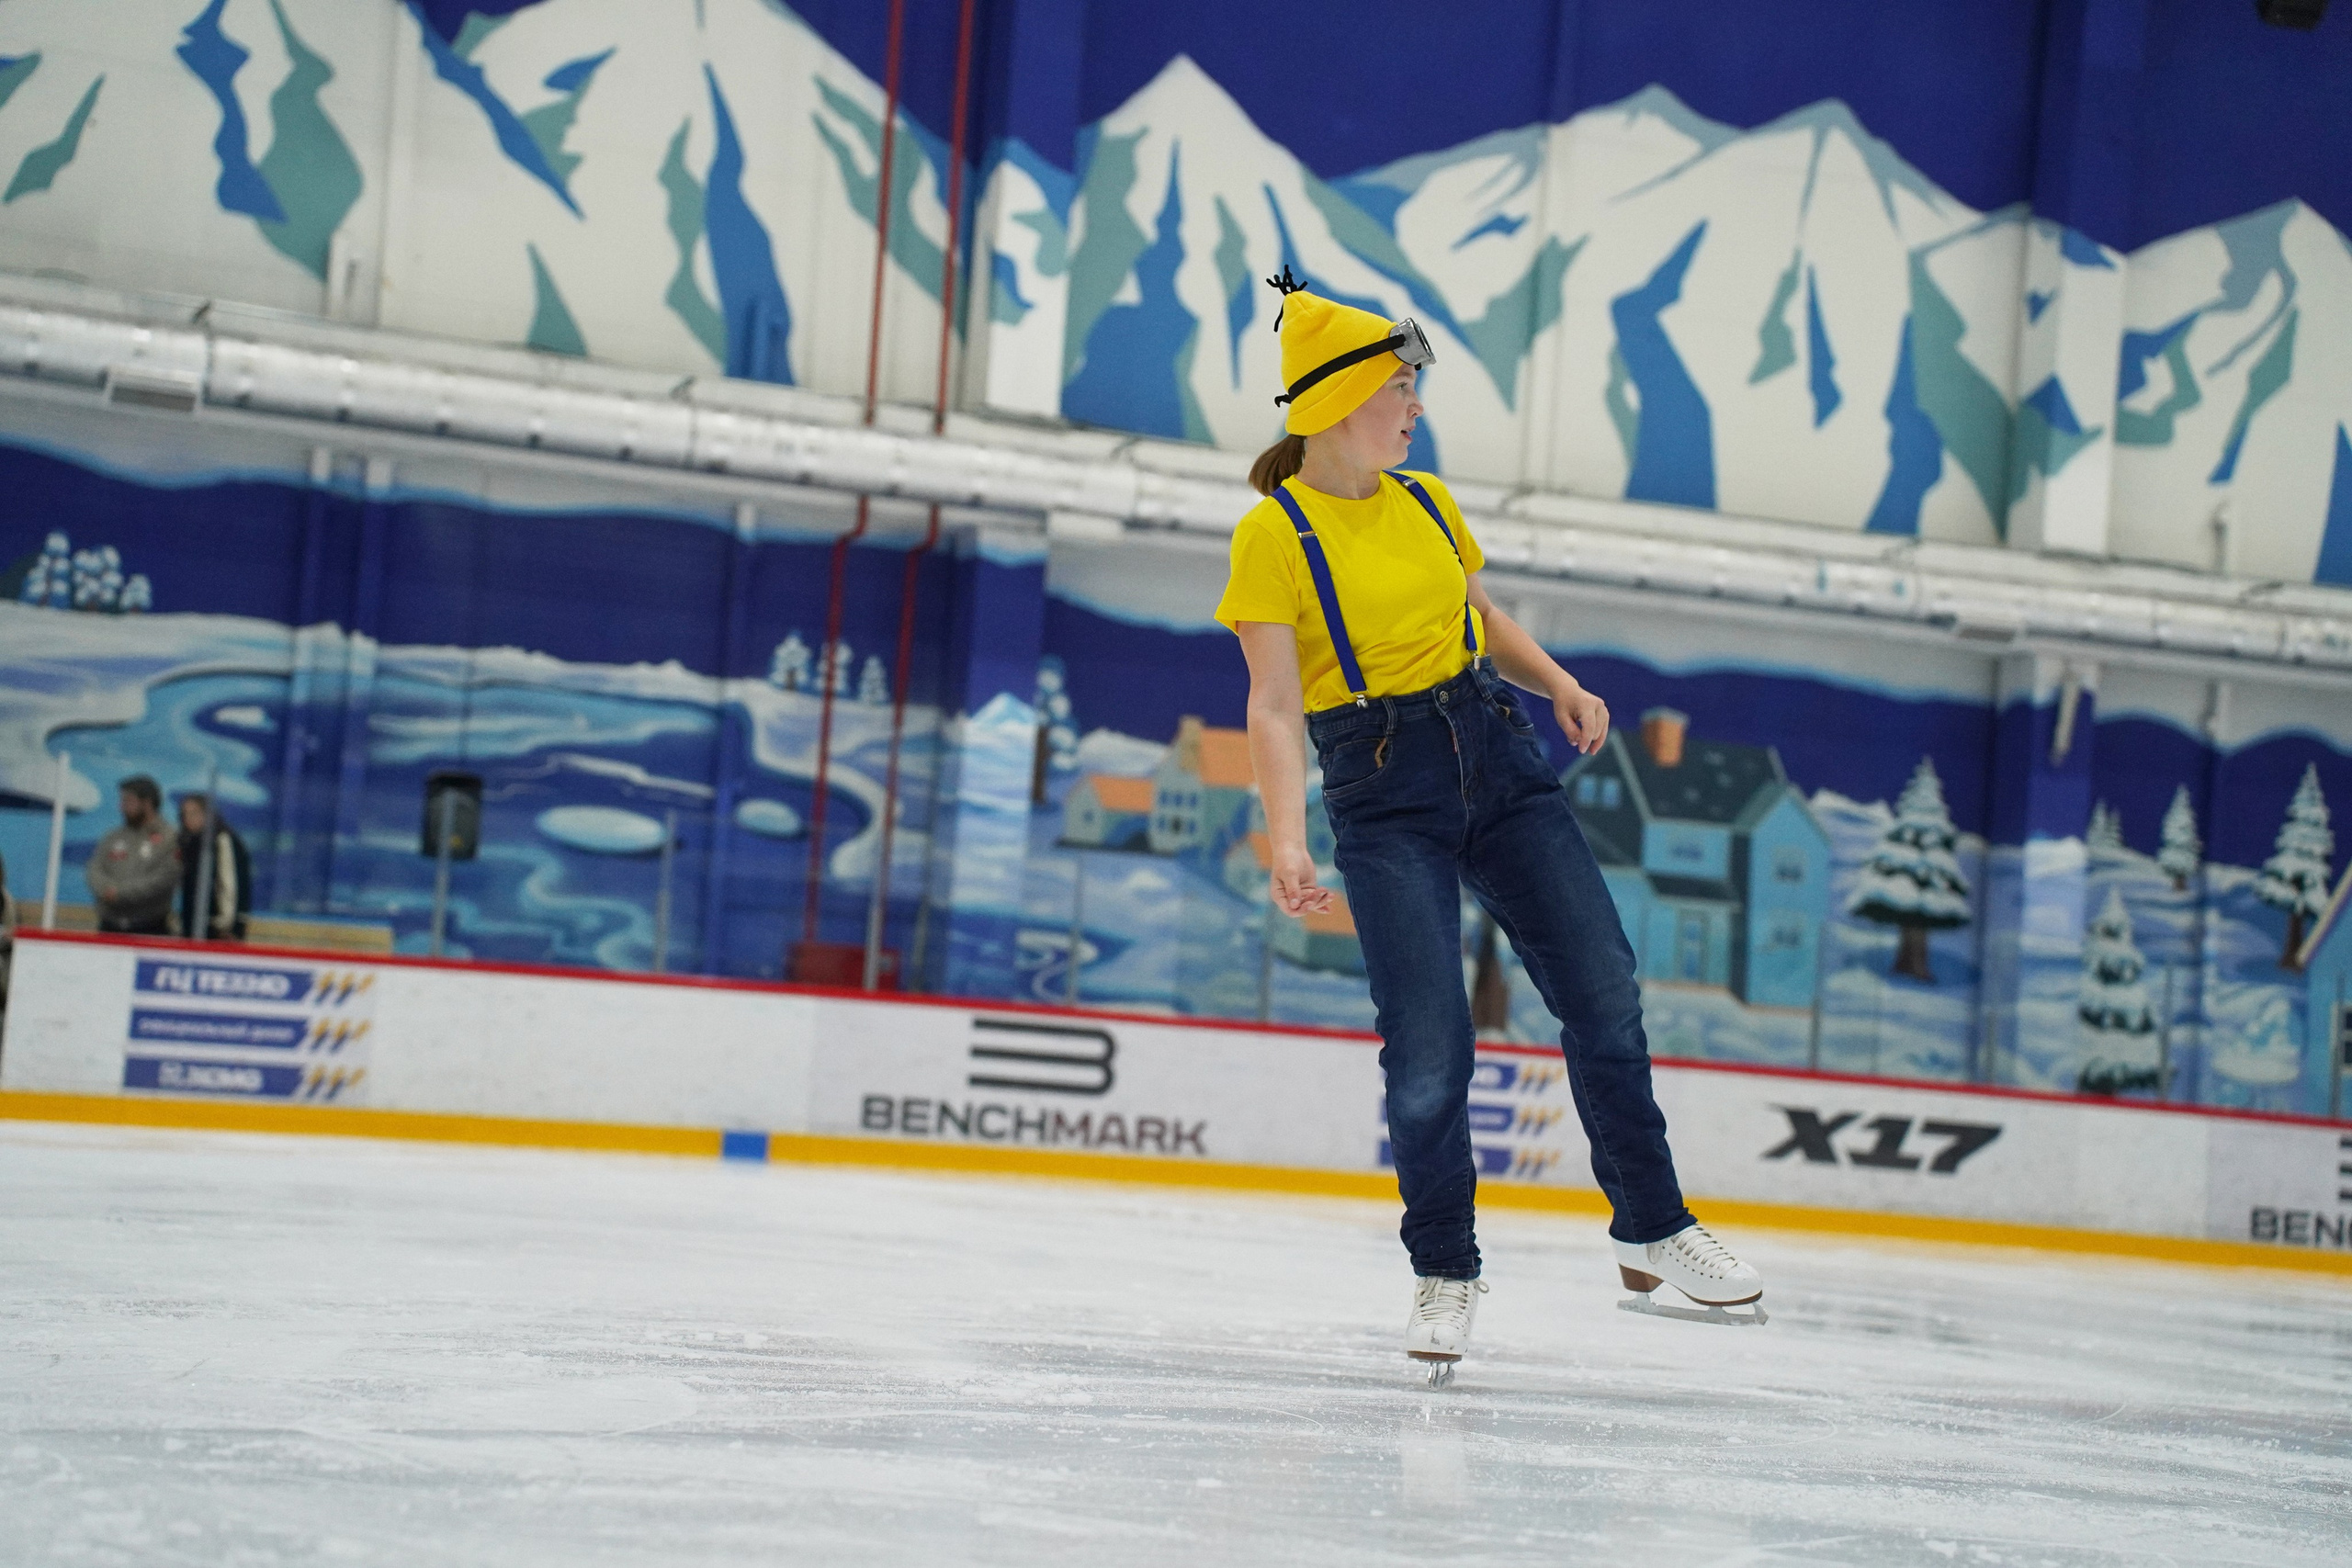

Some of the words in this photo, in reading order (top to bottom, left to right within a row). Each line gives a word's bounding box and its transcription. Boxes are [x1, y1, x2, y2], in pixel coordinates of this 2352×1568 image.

[861, 1095, 1209, 1156] BENCHMARK
[1760, 1104, 2003, 1175] X17
[2250, 1207, 2352, 1247] BEN
